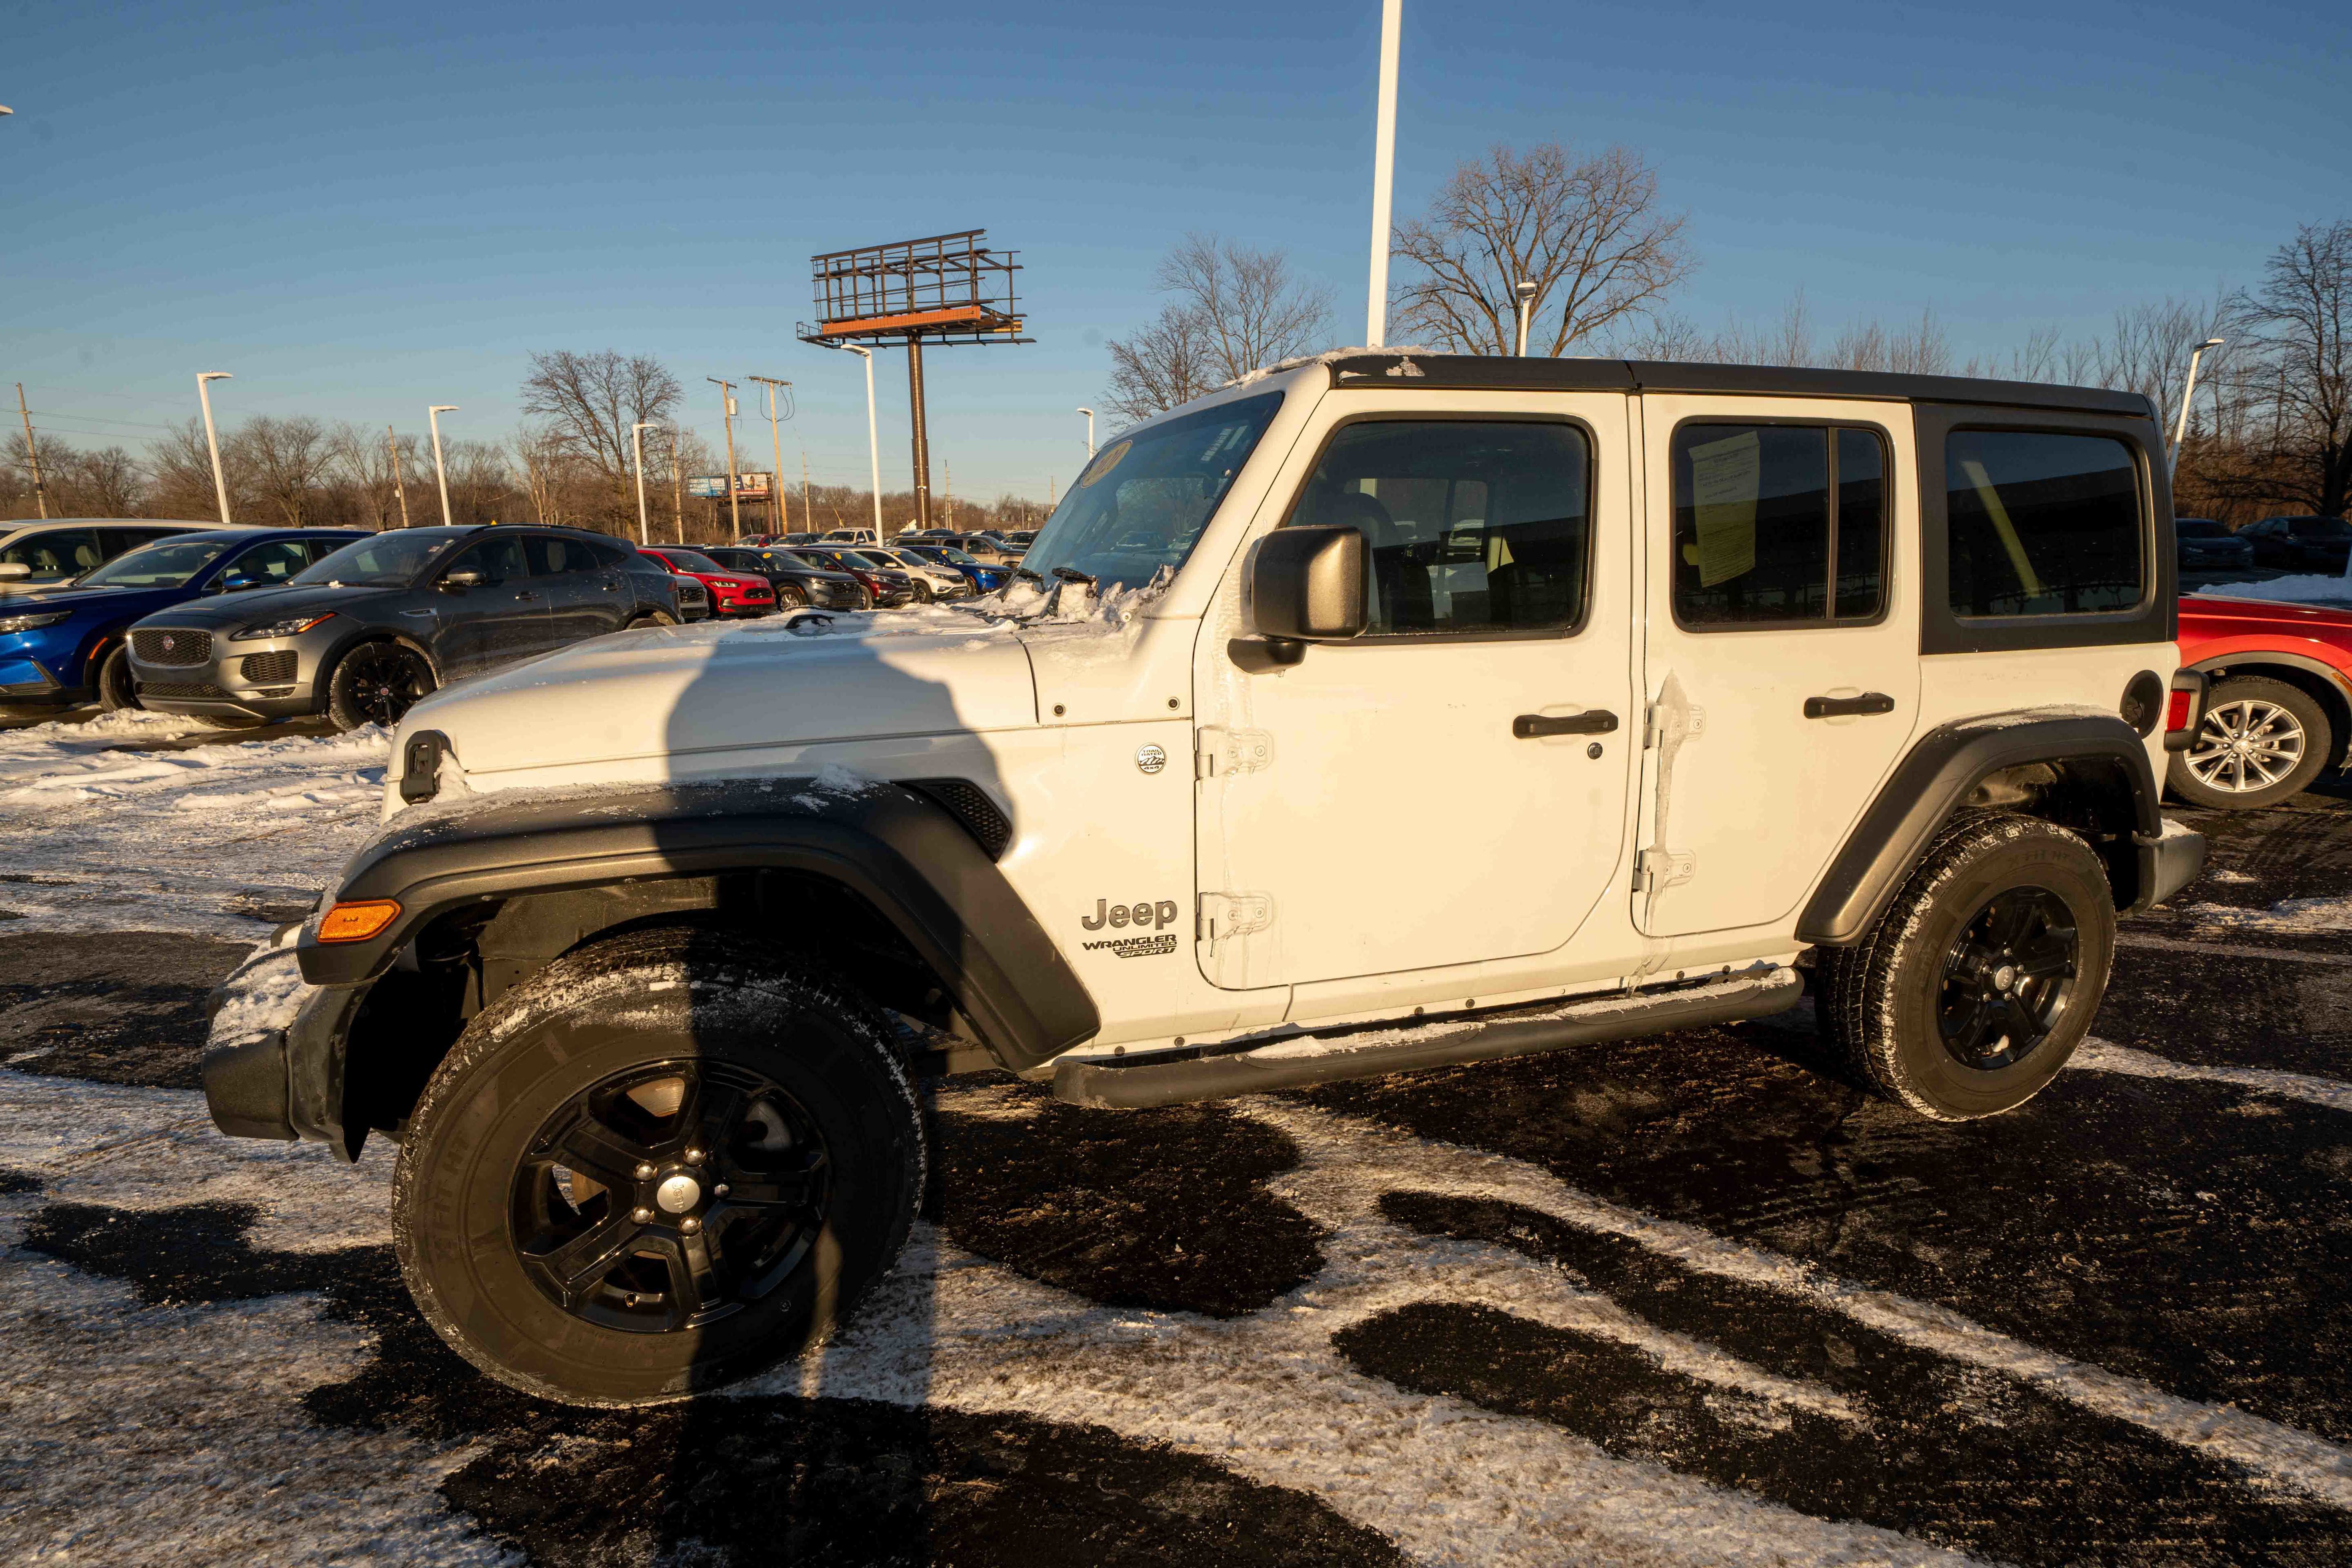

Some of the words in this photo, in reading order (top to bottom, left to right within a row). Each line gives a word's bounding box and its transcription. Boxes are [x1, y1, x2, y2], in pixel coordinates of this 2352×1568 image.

[1081, 898, 1178, 931] Jeep
[1082, 934, 1177, 951] WRANGLER
[1113, 941, 1177, 952] UNLIMITED
[1120, 948, 1174, 957] SPORT
[672, 1181, 686, 1209] Jeep
